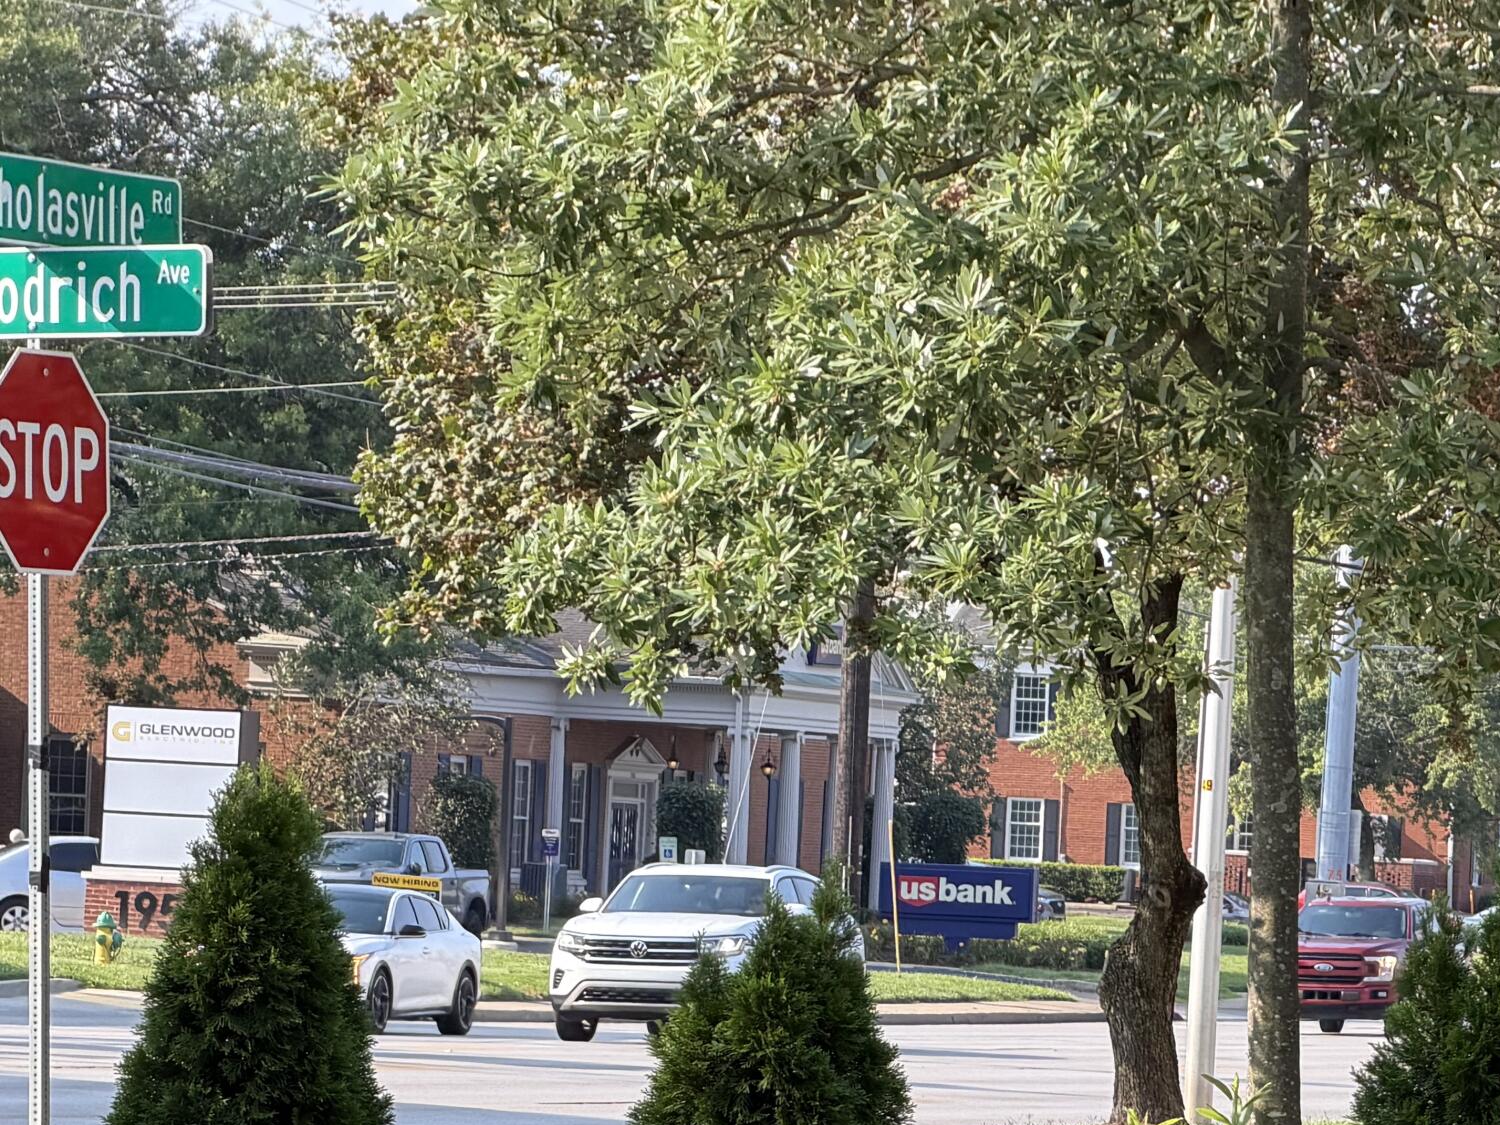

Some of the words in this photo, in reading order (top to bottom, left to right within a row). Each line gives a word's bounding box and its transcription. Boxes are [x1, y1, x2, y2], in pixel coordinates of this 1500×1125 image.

[152, 190, 172, 215] Rd
[0, 260, 141, 324] odrich
[157, 260, 190, 285] Ave
[0, 417, 100, 504] STOP
[140, 723, 235, 739] GLENWOOD
[373, 875, 400, 885] NOW
[402, 878, 439, 888] HIRING
